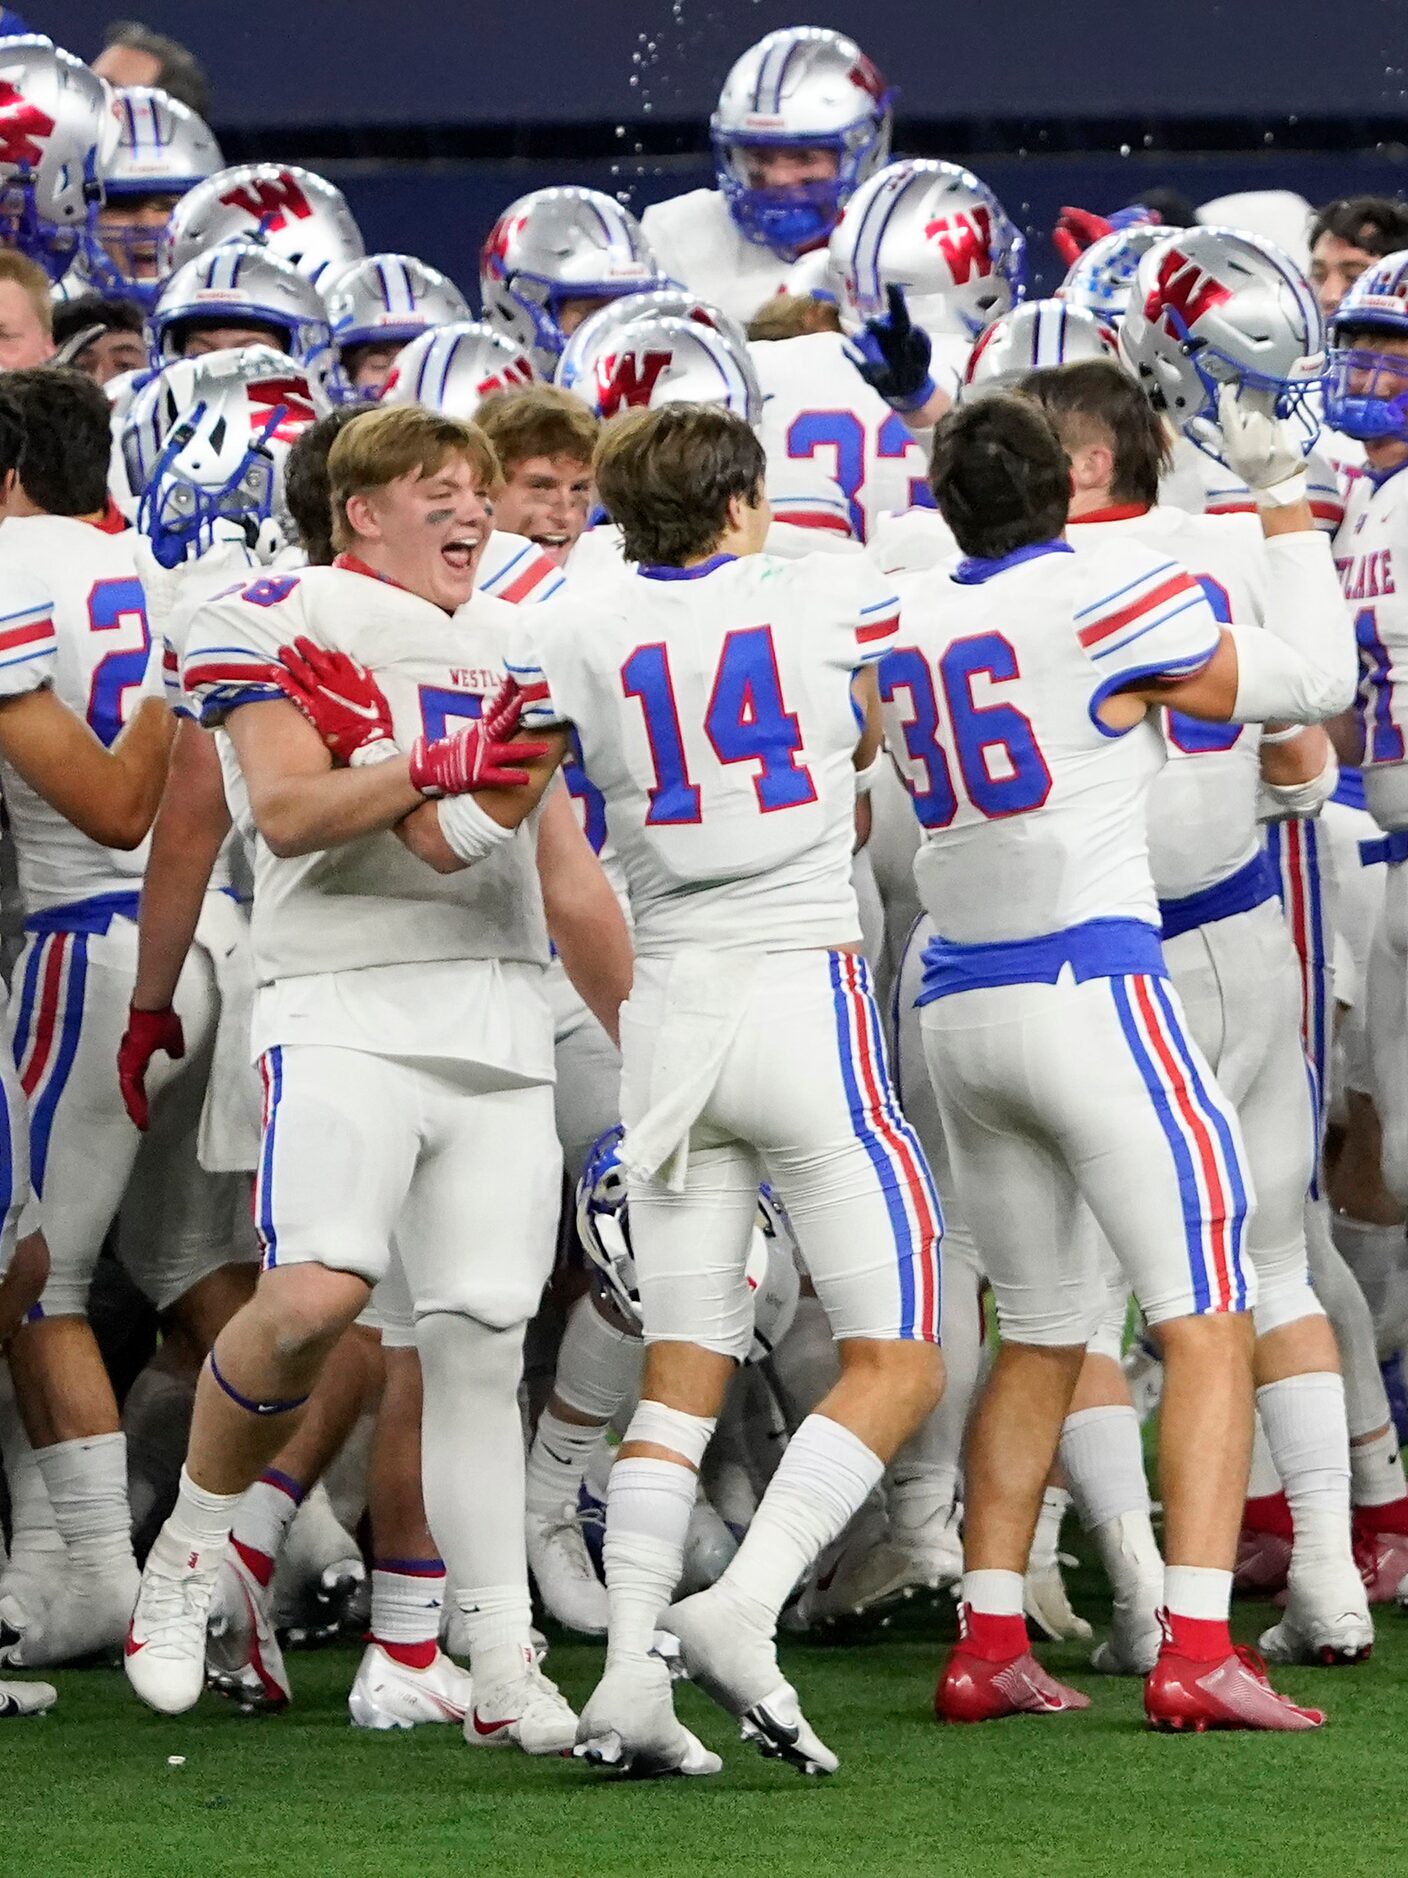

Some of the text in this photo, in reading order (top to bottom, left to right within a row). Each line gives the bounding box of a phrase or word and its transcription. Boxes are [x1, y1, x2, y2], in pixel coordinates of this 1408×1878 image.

[925, 206, 993, 286] W
[1143, 248, 1233, 341] W
[596, 351, 673, 419] W
[620, 623, 818, 826] 14
[878, 629, 1054, 831] 36
